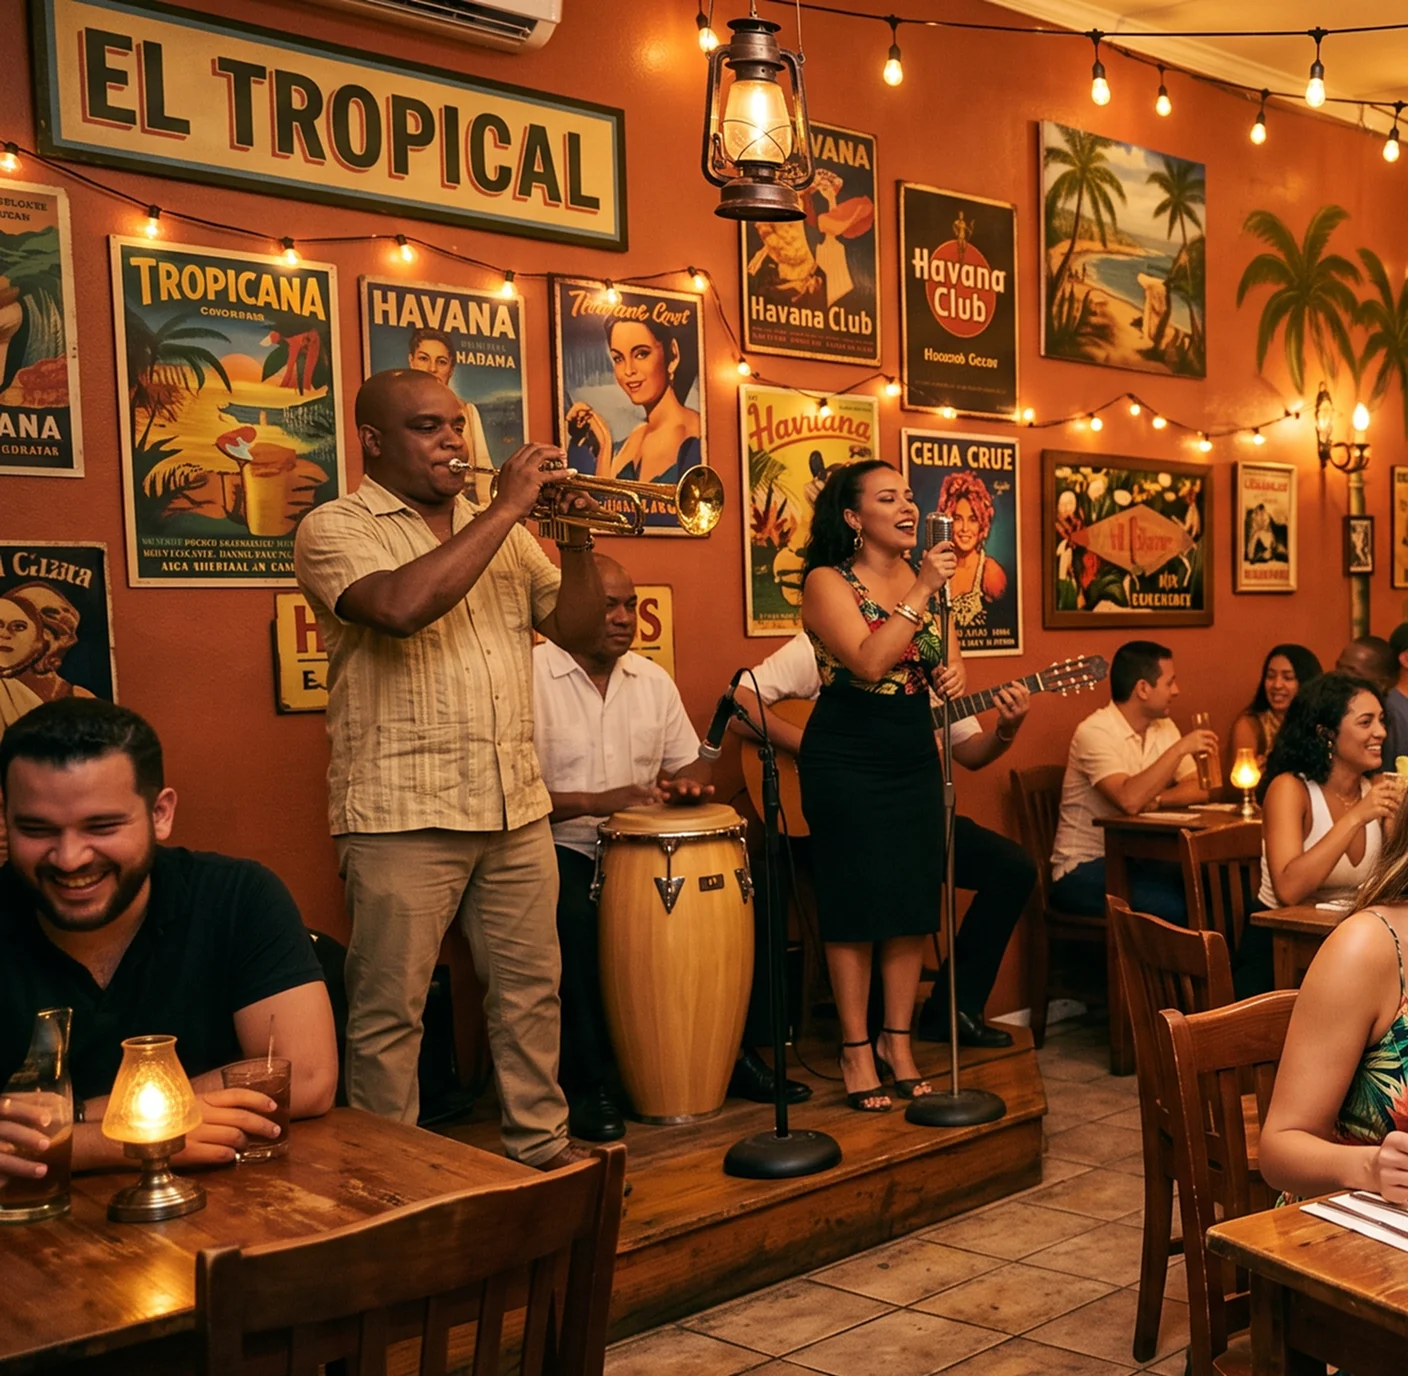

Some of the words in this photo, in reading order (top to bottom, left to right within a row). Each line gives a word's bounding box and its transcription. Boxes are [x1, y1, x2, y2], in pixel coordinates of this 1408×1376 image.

[78, 27, 191, 141] EL
[211, 55, 600, 213] TROPICAL
[793, 131, 871, 170] VANA
[129, 256, 327, 321] TROPICANA
[912, 247, 1006, 294] Havana
[372, 289, 516, 340] HAVANA
[751, 295, 824, 329] Havana
[828, 306, 872, 335] Club
[934, 286, 986, 323] Club
[0, 412, 62, 440] ANA
[910, 441, 962, 468] CELIA
[966, 445, 1013, 470] CRUE
